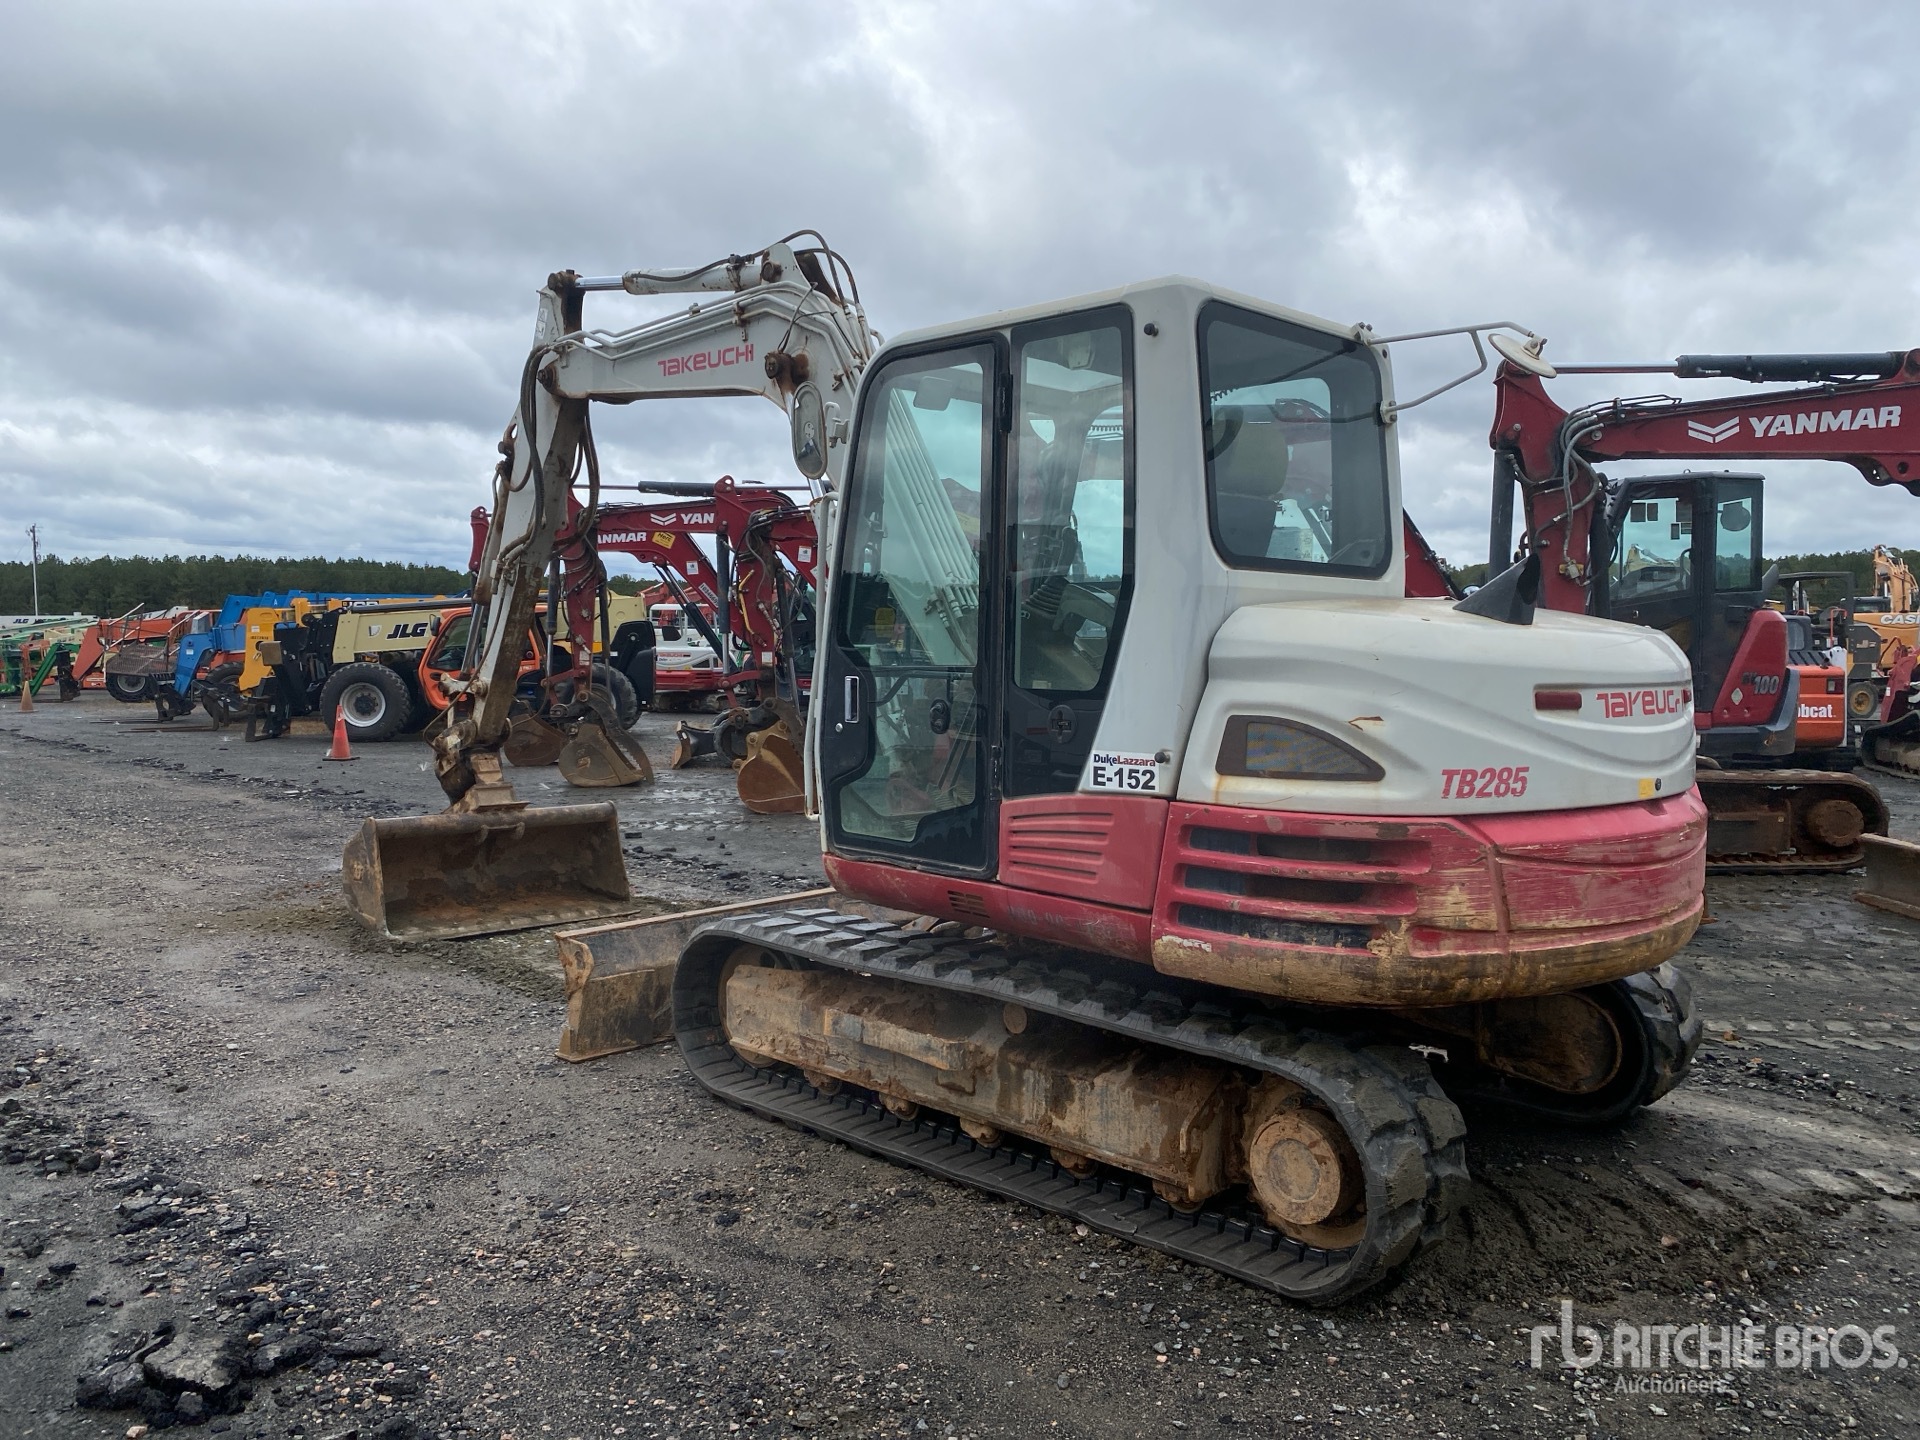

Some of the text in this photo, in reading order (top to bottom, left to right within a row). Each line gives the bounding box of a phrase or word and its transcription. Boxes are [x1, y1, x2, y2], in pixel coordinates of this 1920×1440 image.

[658, 344, 754, 376] TAKEUCHI
[1749, 406, 1902, 437] YANMAR
[680, 513, 715, 524] YAN
[598, 532, 647, 544] NMAR
[386, 622, 429, 639] JLG
[1797, 704, 1833, 718] bcat
[1093, 754, 1156, 766] DukeLazzara
[1092, 766, 1156, 791] E-152
[1441, 767, 1530, 799] TB285
